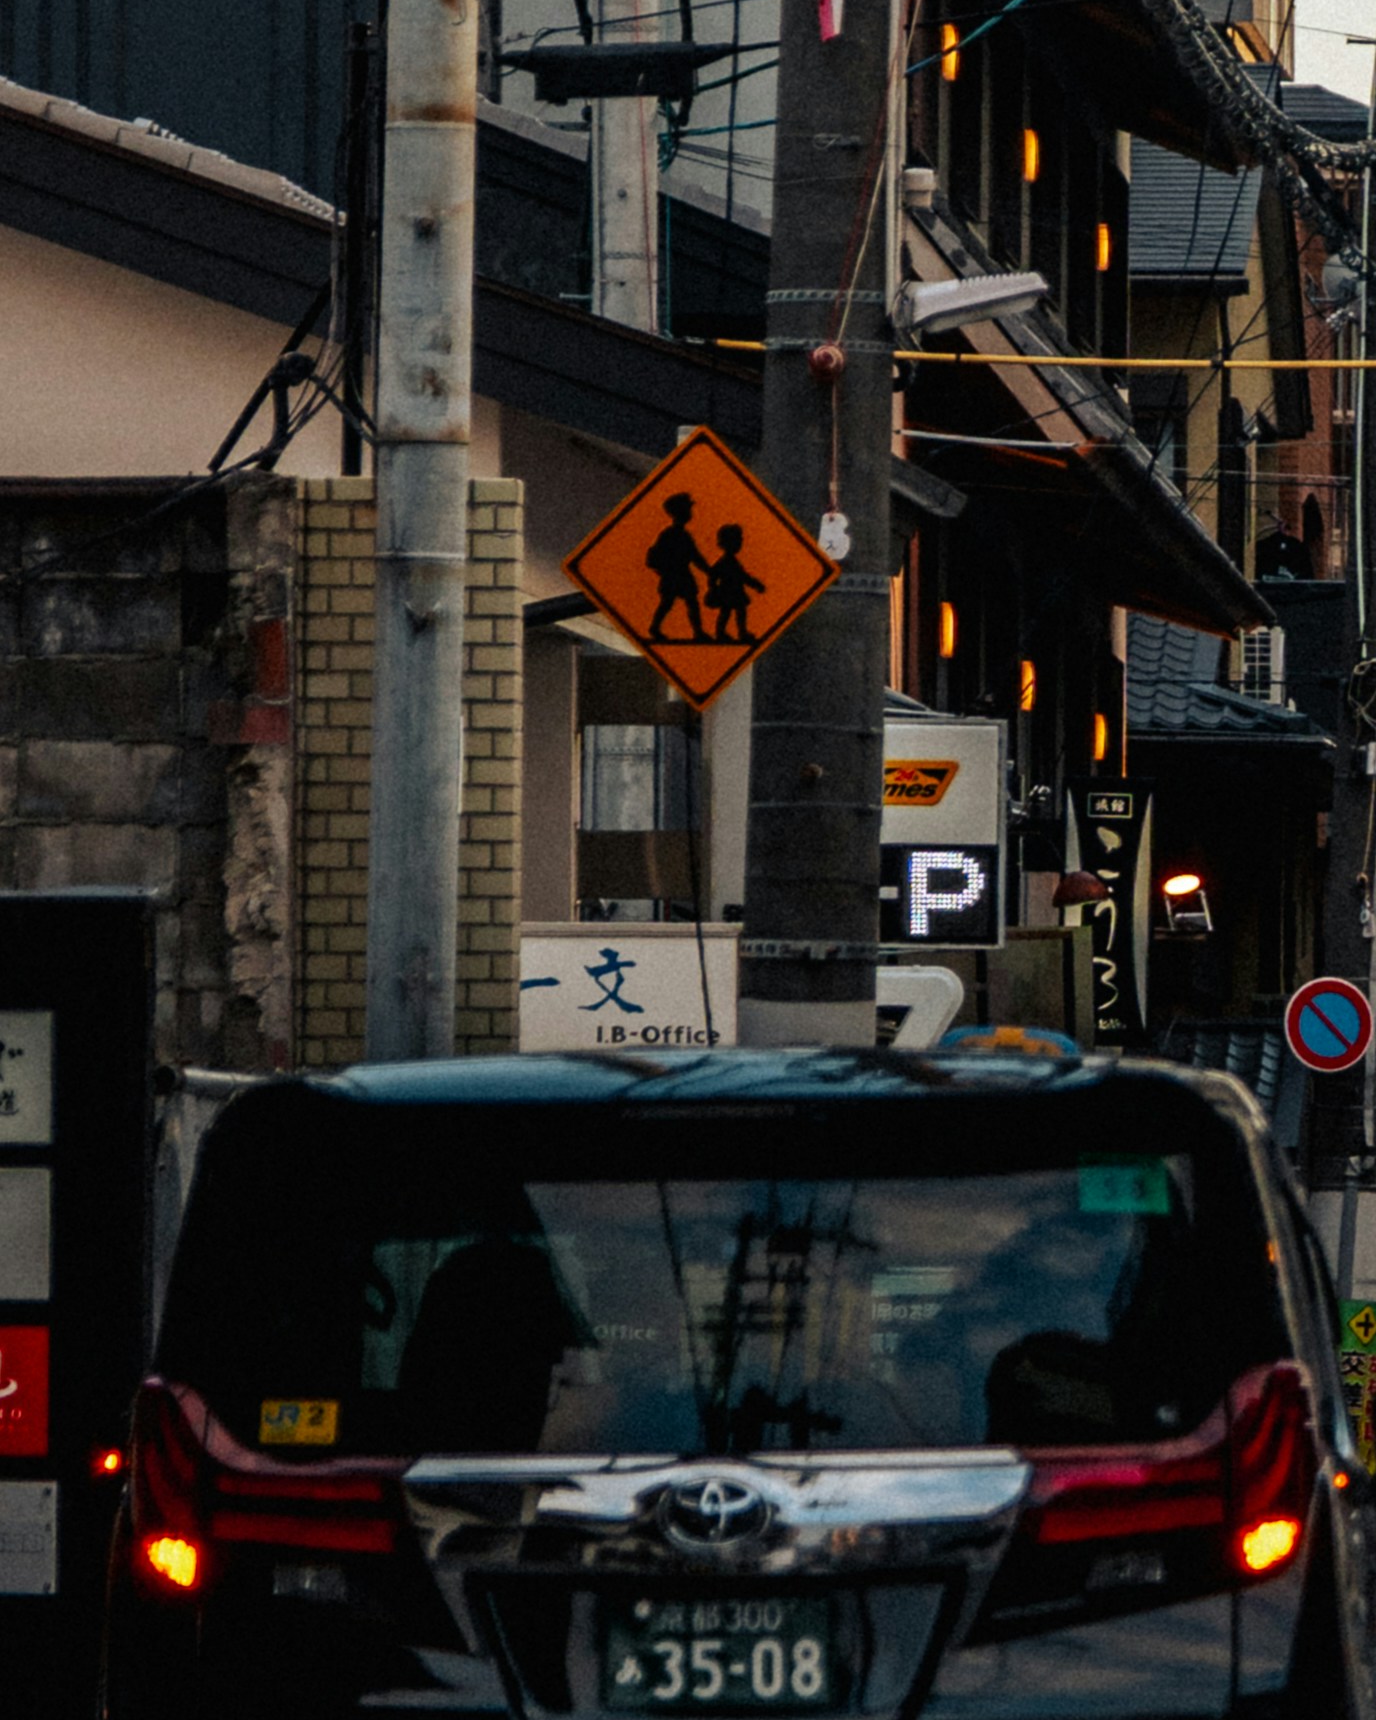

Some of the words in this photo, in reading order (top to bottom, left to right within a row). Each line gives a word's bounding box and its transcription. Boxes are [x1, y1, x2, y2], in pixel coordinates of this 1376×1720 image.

[908, 851, 984, 936] P
[520, 947, 645, 1014] 一文
[596, 1025, 721, 1045] I.B-Office
[727, 1599, 783, 1631] 300
[652, 1638, 823, 1700] 35-08
